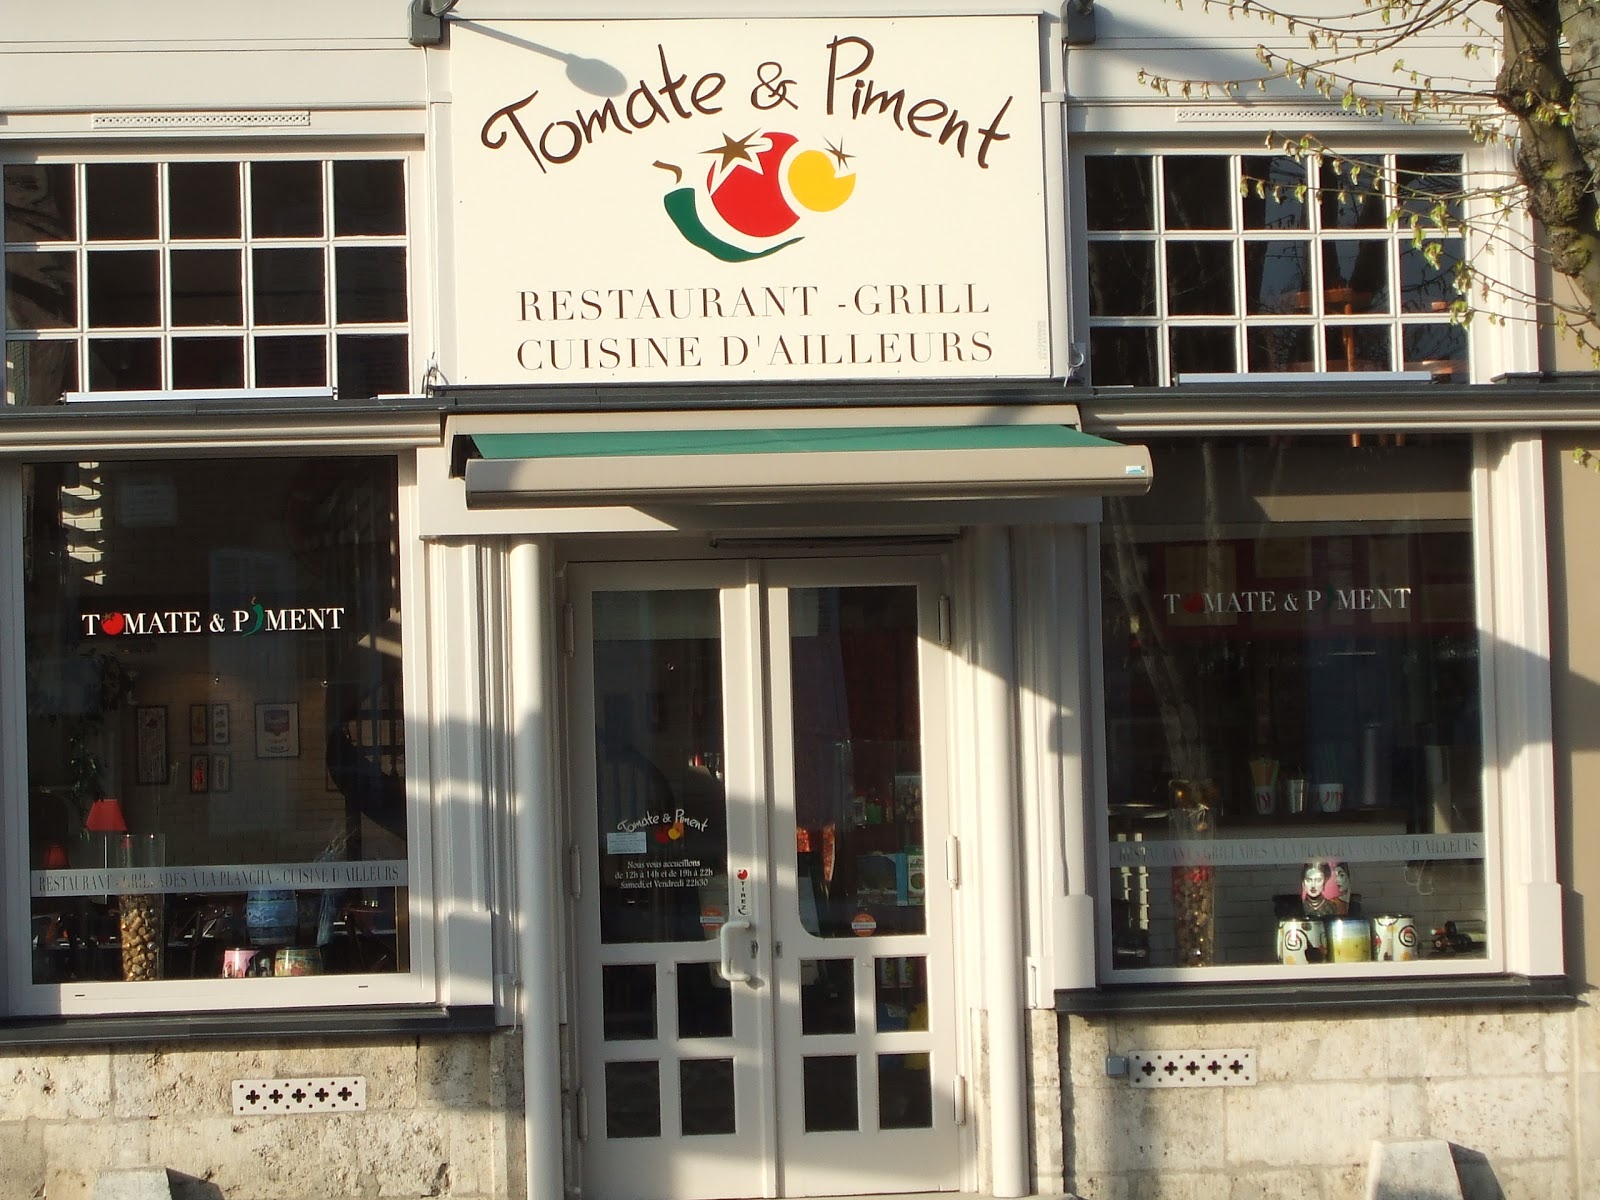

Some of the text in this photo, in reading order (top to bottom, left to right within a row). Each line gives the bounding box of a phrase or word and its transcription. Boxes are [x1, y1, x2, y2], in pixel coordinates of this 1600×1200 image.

[481, 35, 1014, 174] Tomate & Piment
[516, 286, 818, 321] RESTAURANT
[516, 336, 701, 371] CUISINE
[720, 331, 993, 367] D'AILLEURS
[1284, 593, 1300, 612] &
[209, 613, 226, 633] &
[617, 808, 709, 833] Tomate & Piment
[38, 873, 113, 892] RESTAURANT
[219, 869, 272, 886] PLANCHA
[283, 867, 329, 884] CUISINE
[700, 867, 714, 877] 22h
